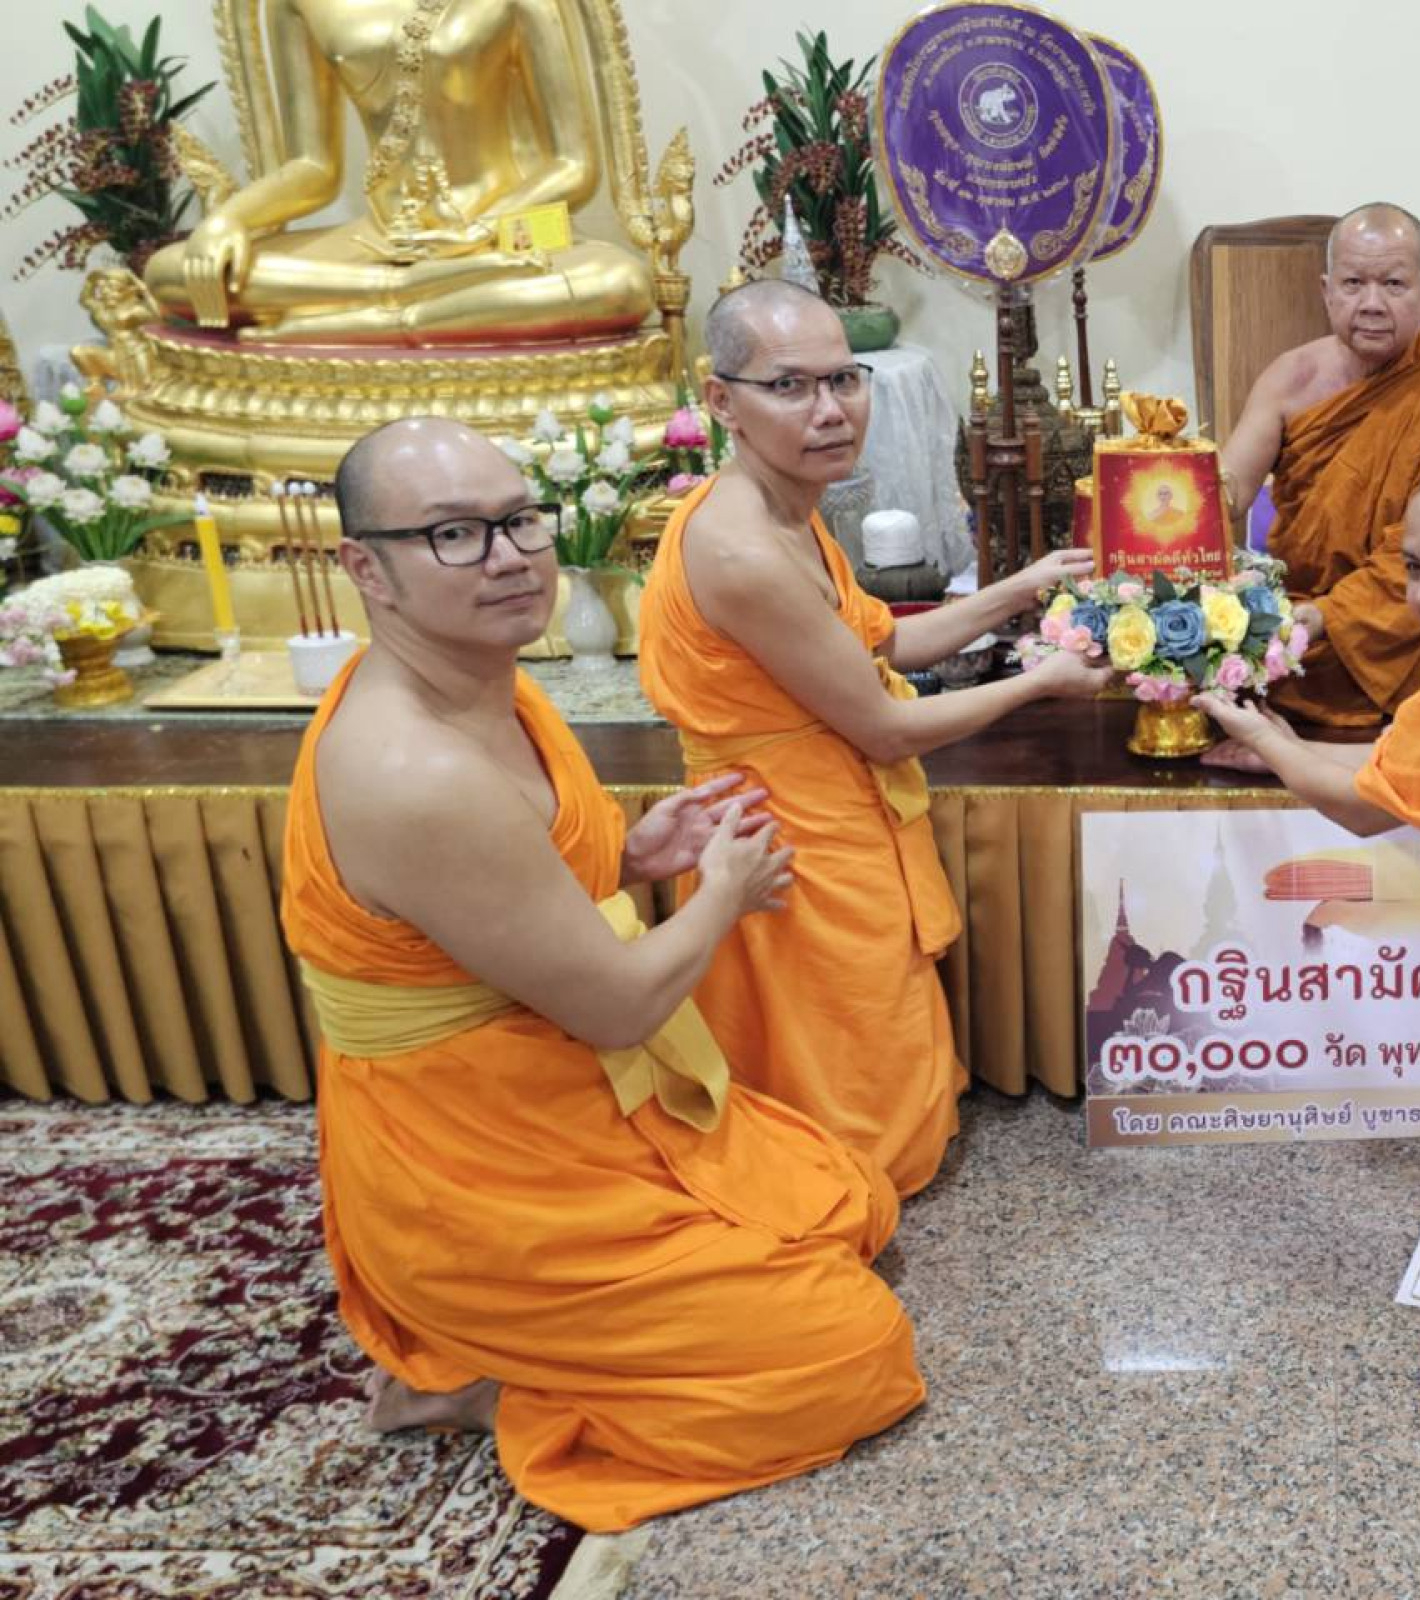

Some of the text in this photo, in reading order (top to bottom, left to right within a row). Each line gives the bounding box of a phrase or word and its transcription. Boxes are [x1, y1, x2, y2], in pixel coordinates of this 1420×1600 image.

[1109, 1039, 1309, 1080] ๓๐,๐๐๐
[1325, 1032, 1367, 1067] วัด
[1115, 1109, 1160, 1132] โดย
[1170, 1101, 1352, 1133] คณะศิษยานุศิษย์
